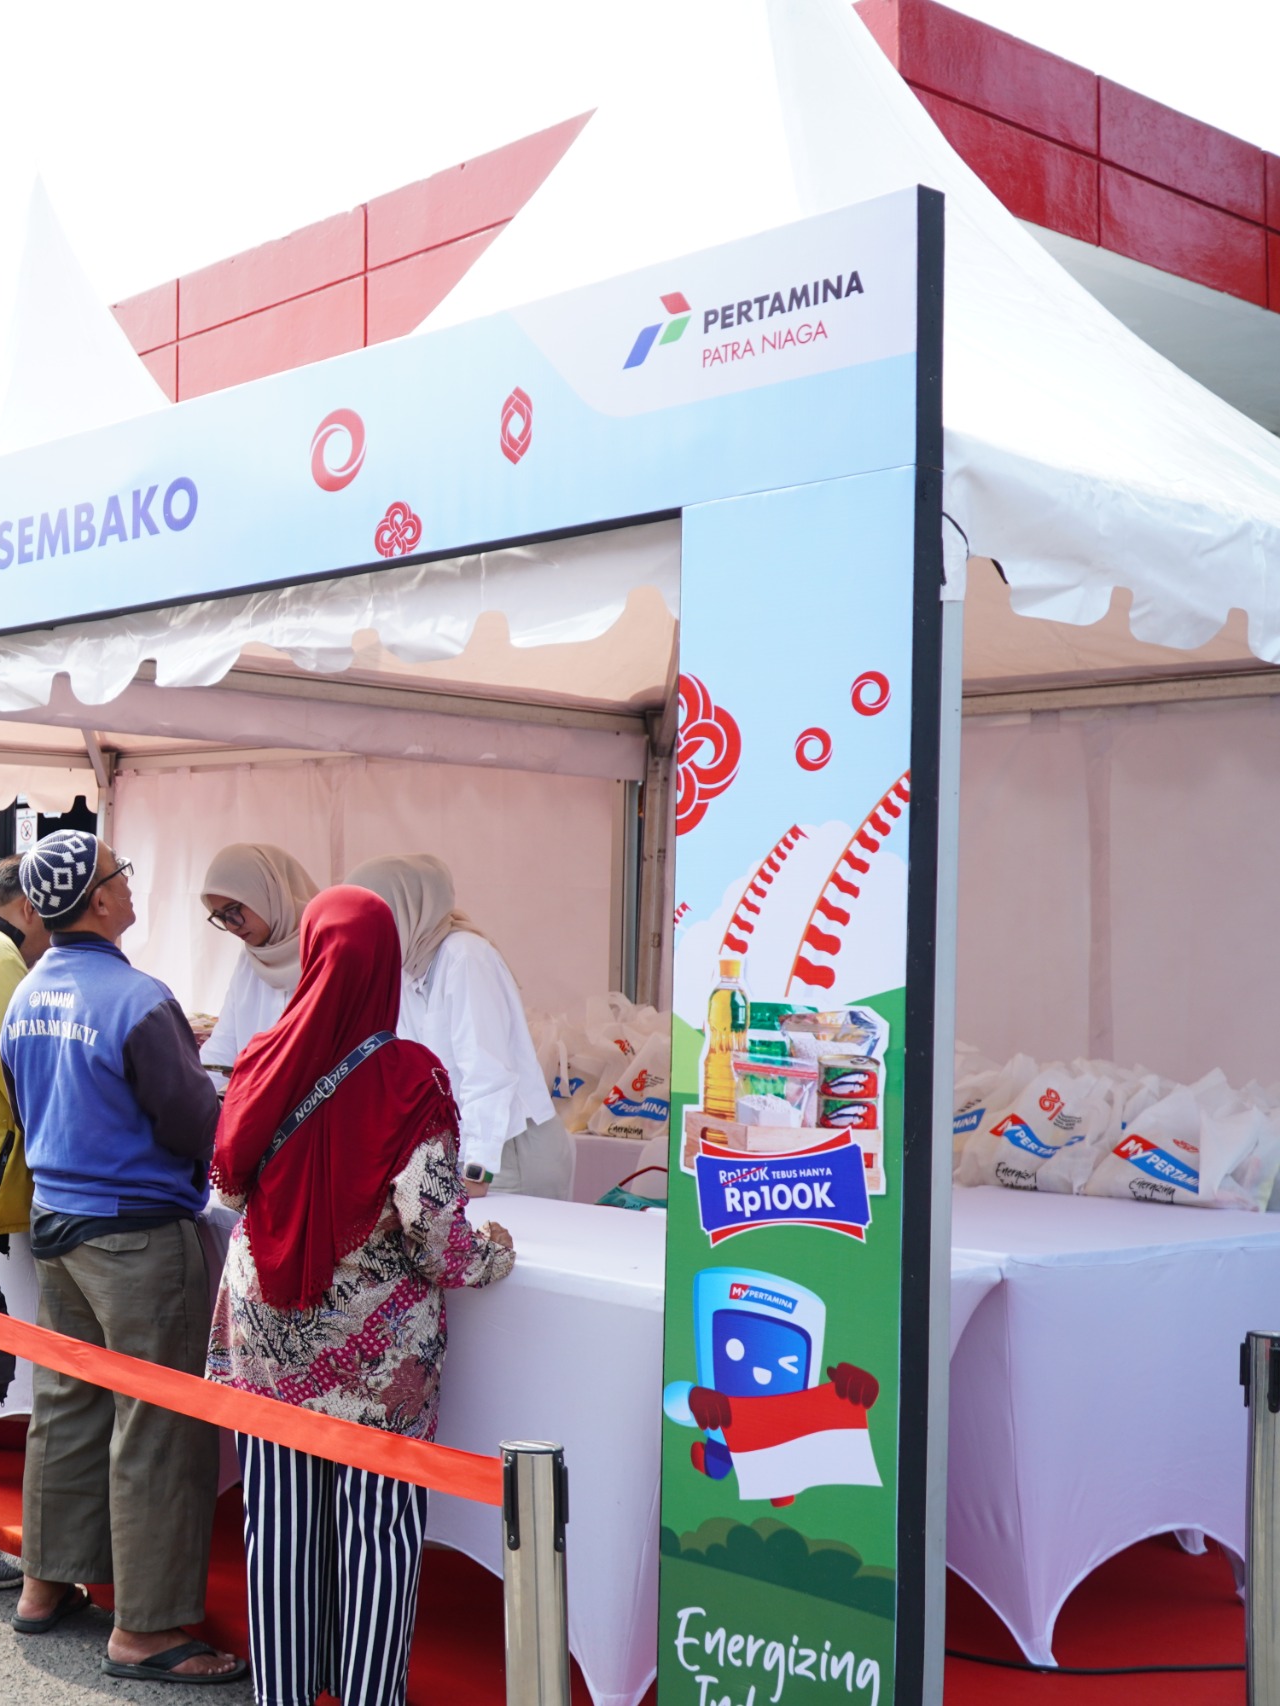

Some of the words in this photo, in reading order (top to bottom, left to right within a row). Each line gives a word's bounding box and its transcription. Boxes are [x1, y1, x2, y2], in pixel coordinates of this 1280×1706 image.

[703, 270, 865, 334] PERTAMINA
[702, 339, 755, 368] PATRA
[762, 320, 828, 354] NIAGA
[40, 991, 75, 1009] YAMAHA
[718, 1166, 770, 1187] Rp150K
[771, 1169, 798, 1179] TEBUS
[799, 1167, 833, 1178] HANYA
[724, 1181, 836, 1218] Rp100K
[673, 1606, 881, 1706] Energizing
